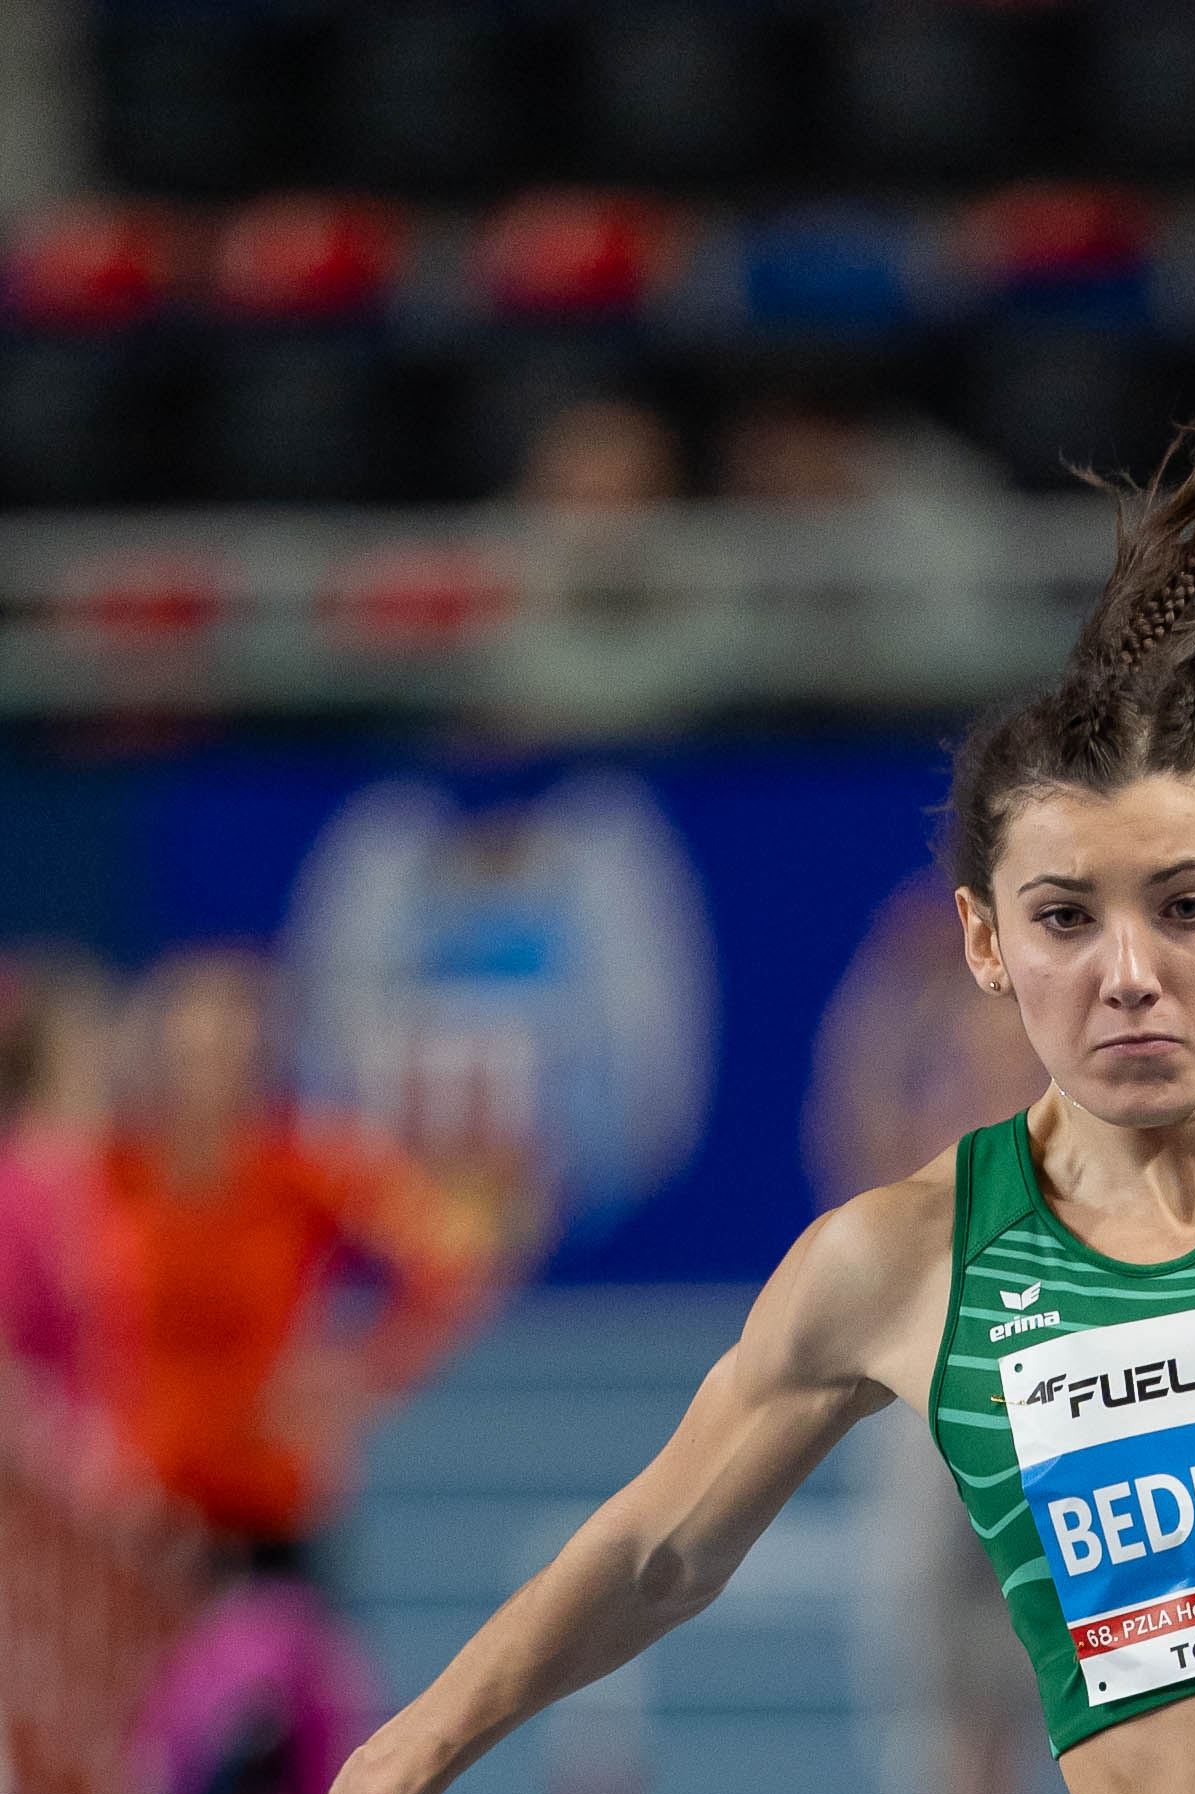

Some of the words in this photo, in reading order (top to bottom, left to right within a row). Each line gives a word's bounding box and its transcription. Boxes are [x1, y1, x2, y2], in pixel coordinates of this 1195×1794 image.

[989, 1310, 1061, 1342] erima
[1086, 1625, 1119, 1648] 68.
[1123, 1610, 1172, 1639] PZLA
